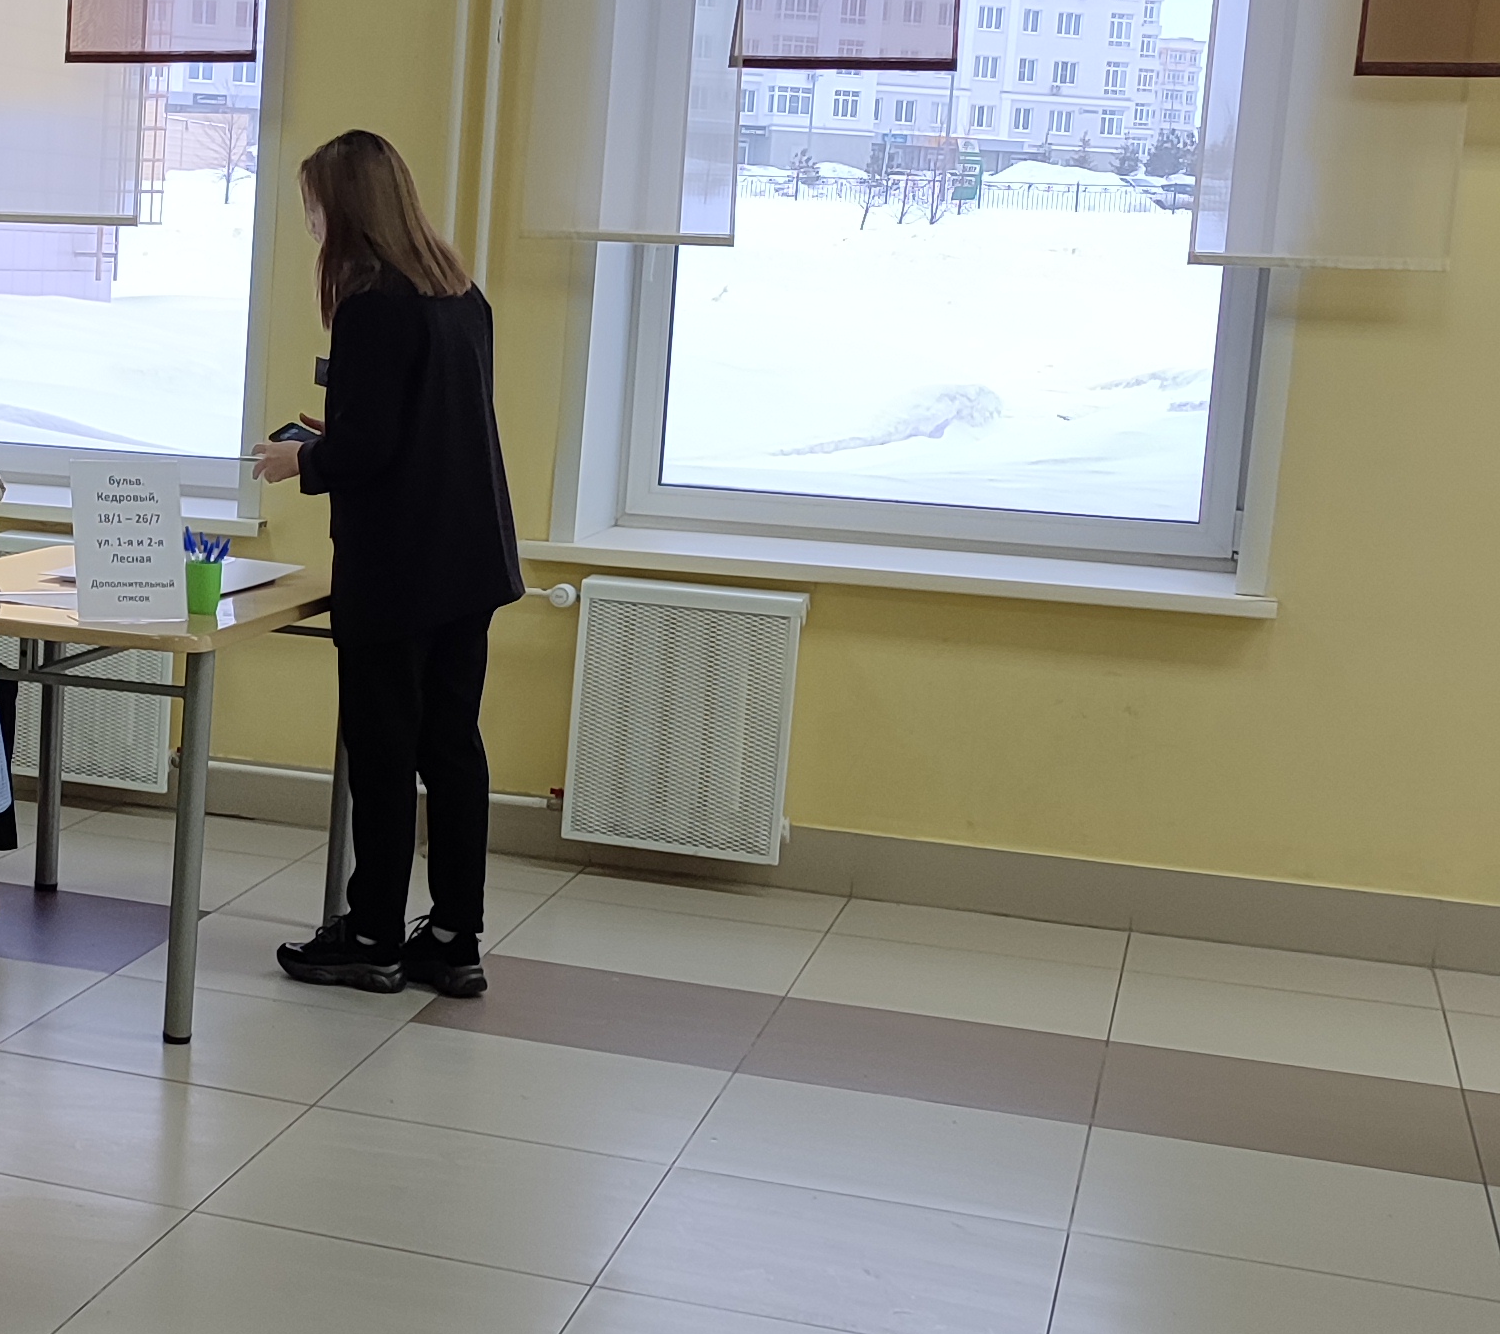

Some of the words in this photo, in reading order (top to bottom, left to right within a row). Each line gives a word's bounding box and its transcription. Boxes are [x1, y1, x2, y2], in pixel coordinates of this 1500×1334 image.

[108, 475, 145, 487] бульв.
[96, 492, 159, 504] Кедровый,
[98, 513, 123, 525] 18/1
[135, 513, 160, 525] 26/7
[97, 538, 114, 548] ул.
[116, 537, 134, 547] 1-я
[136, 539, 144, 547] и
[147, 537, 164, 547] 2-я
[111, 553, 152, 563] Лесная
[90, 579, 175, 589] Дополнительный
